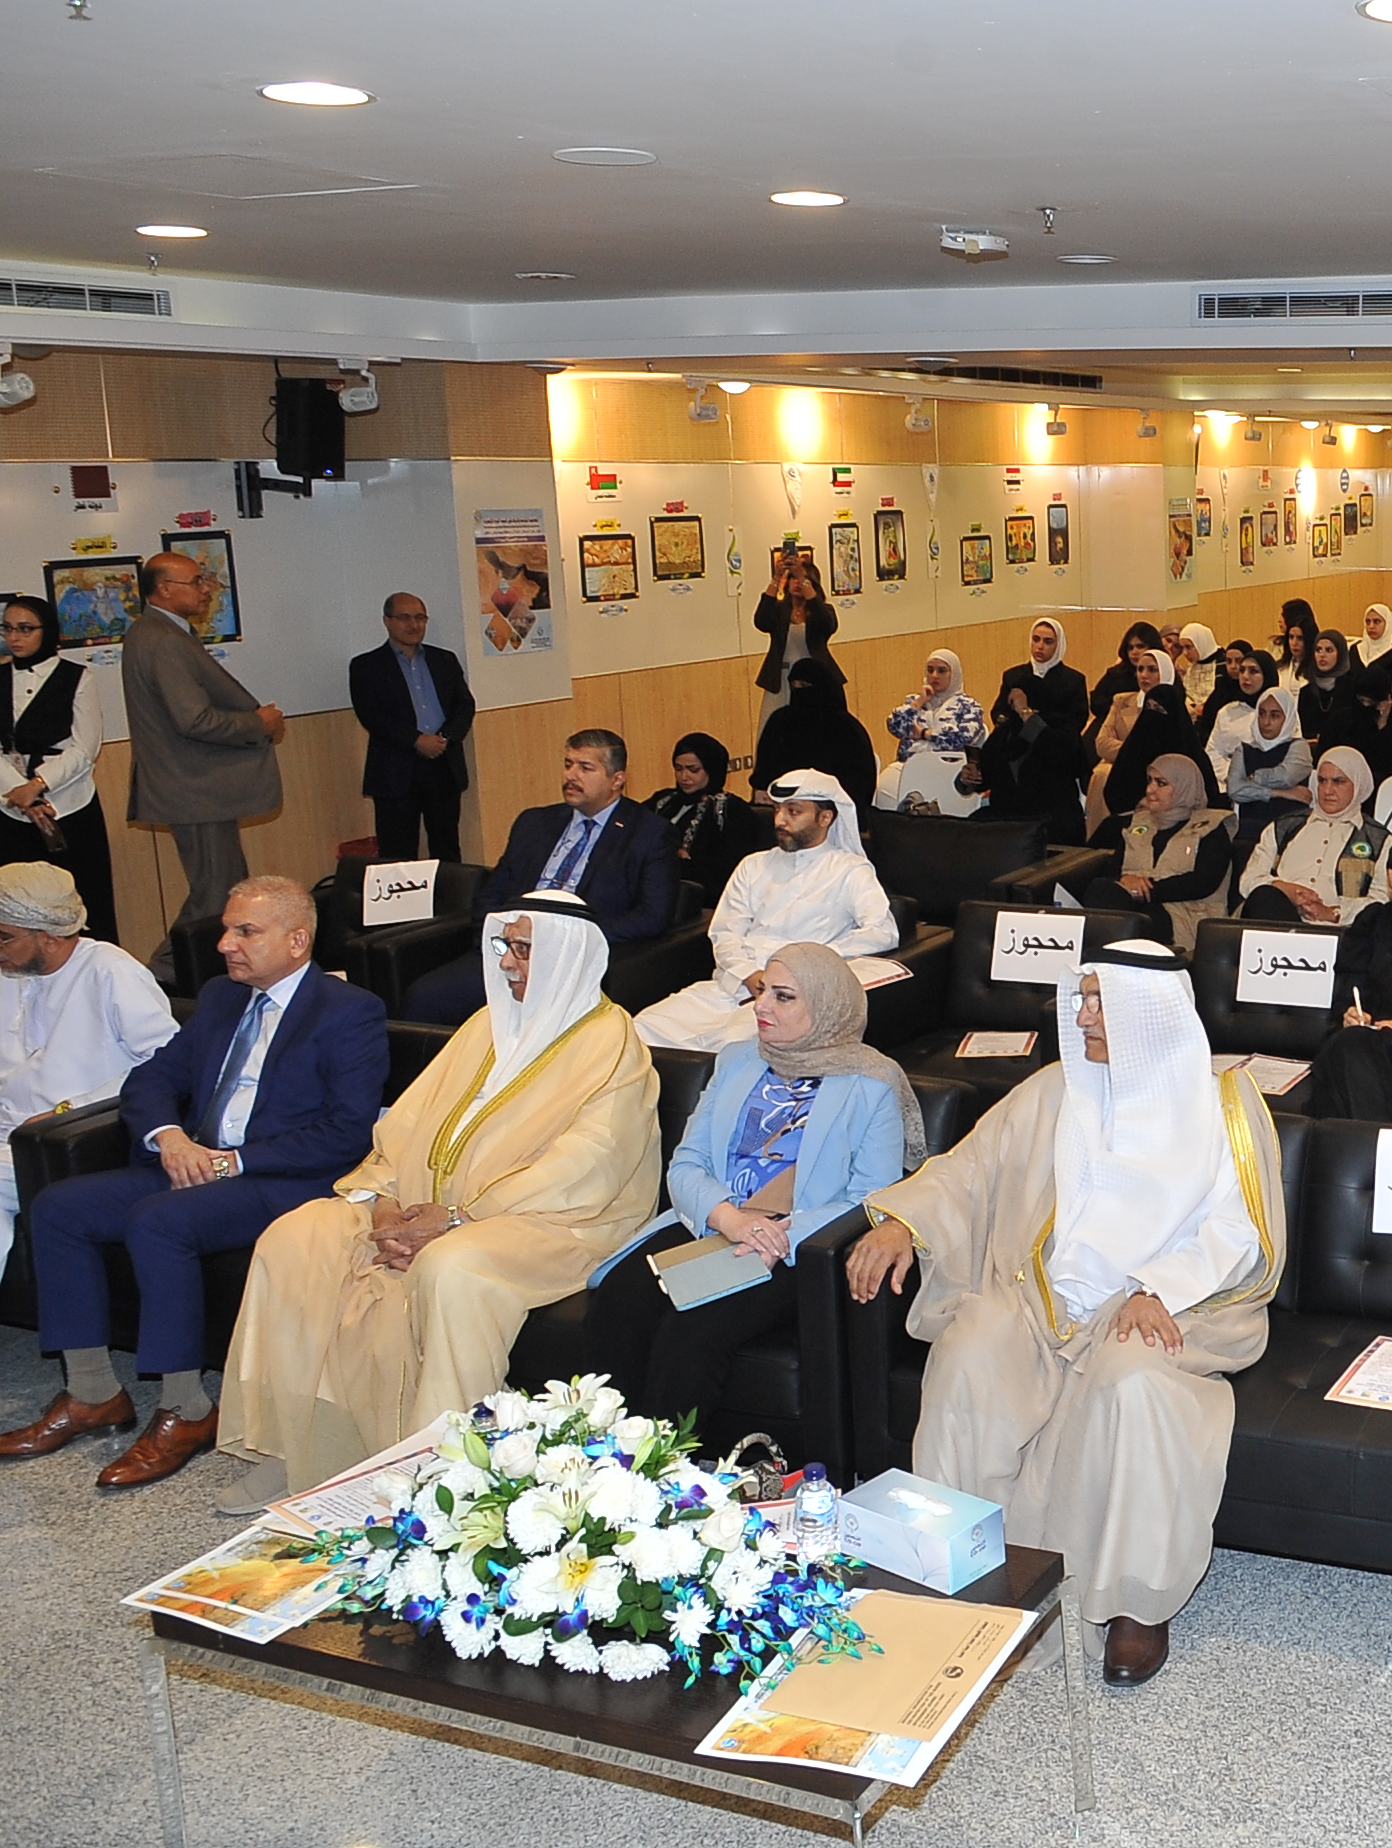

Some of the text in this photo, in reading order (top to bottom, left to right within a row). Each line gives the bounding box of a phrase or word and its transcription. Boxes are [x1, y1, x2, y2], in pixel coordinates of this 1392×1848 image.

[370, 878, 428, 902] محجوز
[1001, 928, 1074, 956] محجوز
[1247, 947, 1327, 977] محجوز
